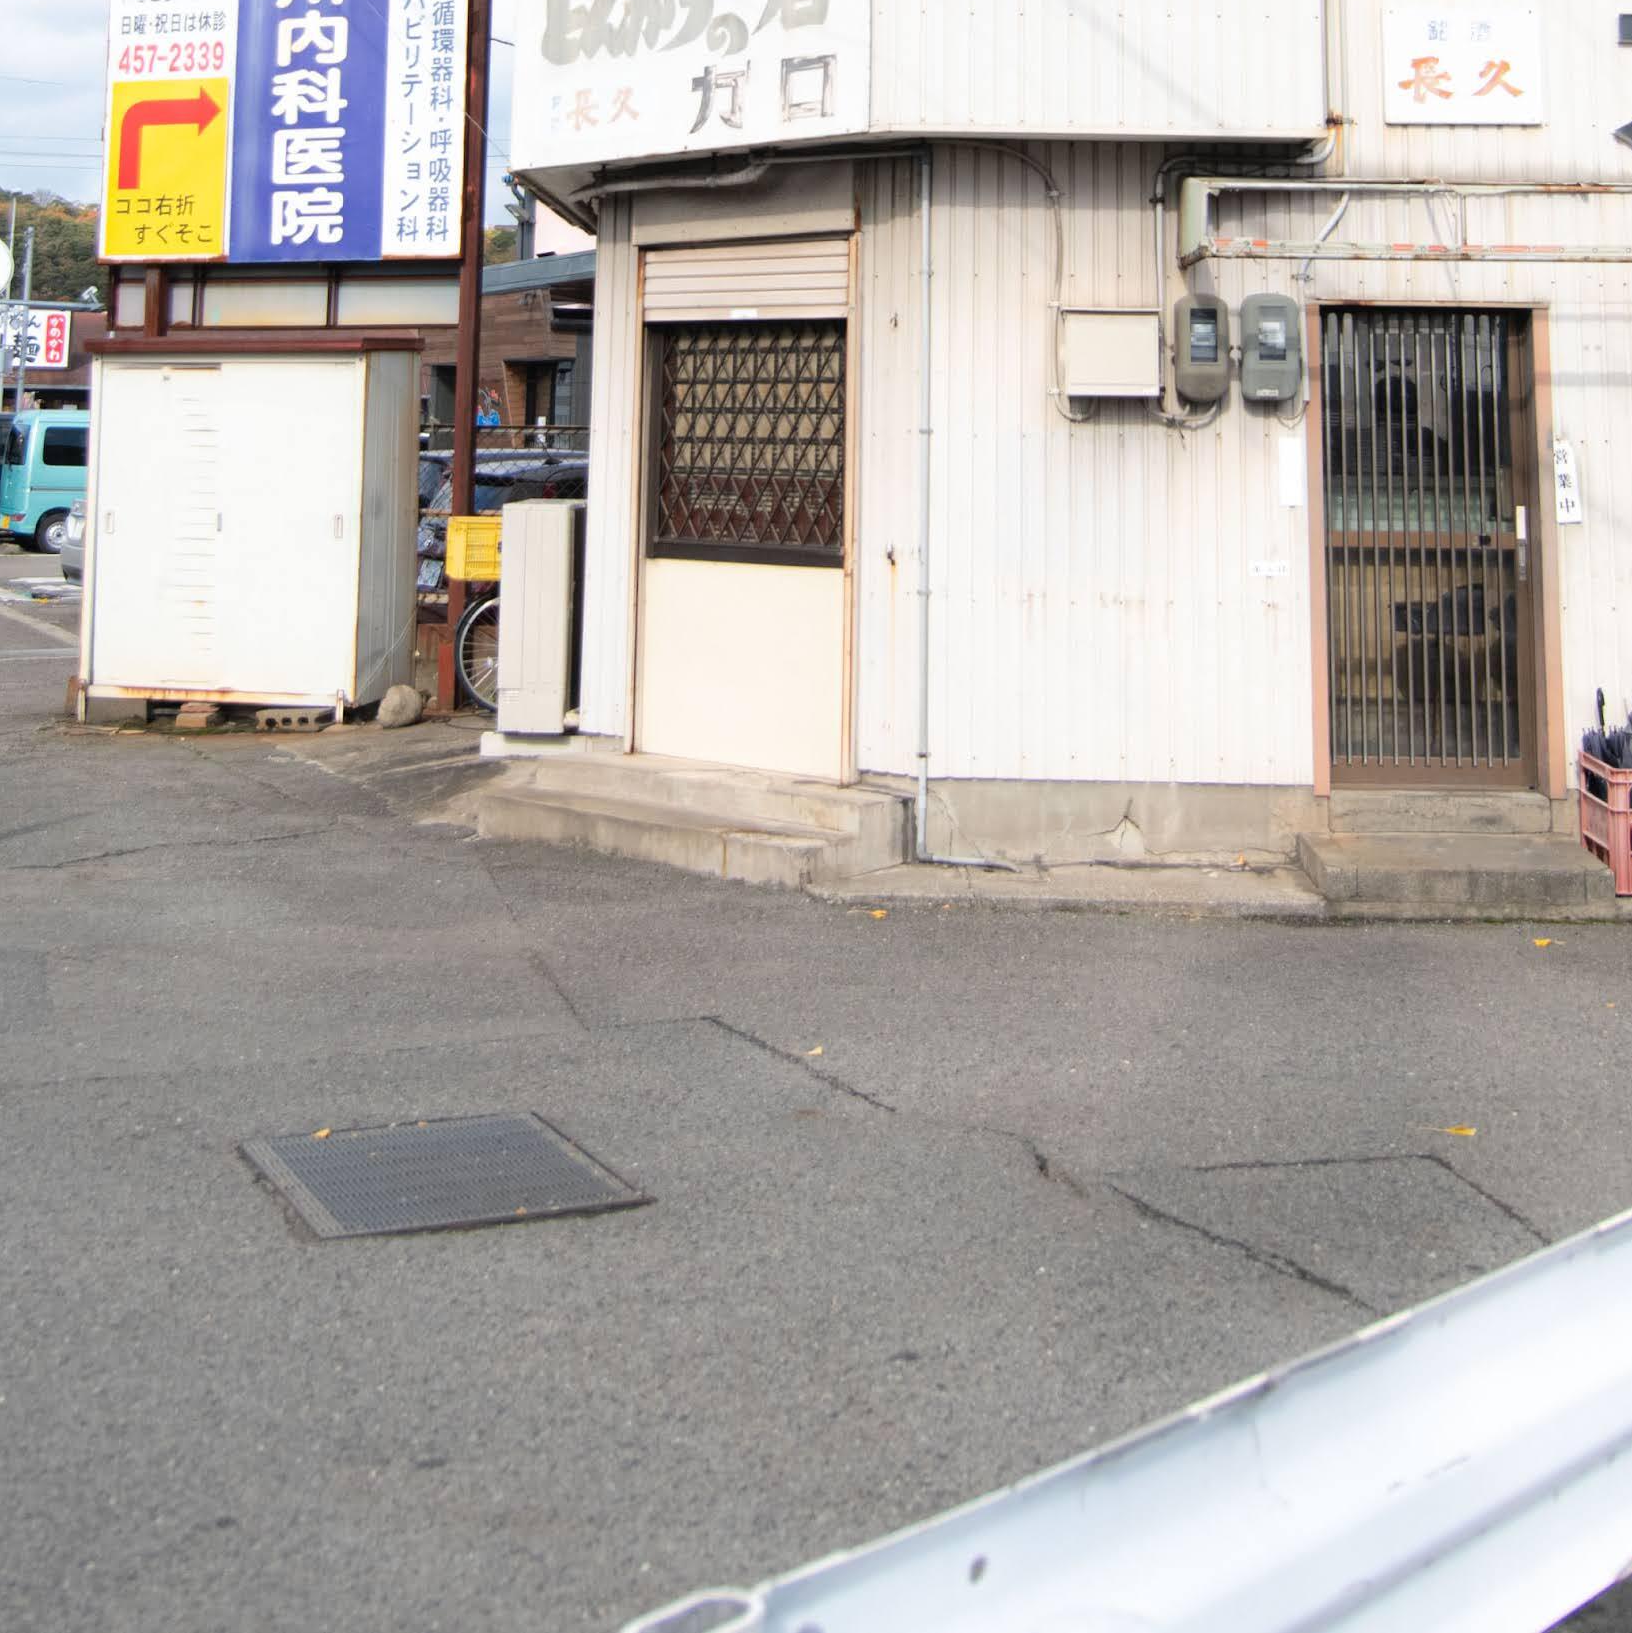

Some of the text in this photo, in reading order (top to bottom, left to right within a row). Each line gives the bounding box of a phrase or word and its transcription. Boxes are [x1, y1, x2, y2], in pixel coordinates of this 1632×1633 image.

[118, 40, 225, 74] 457-2339
[1397, 56, 1525, 104] 長久
[115, 194, 196, 217] ココ右折
[134, 223, 213, 245] すぐそこ
[1554, 447, 1576, 514] 営業中
